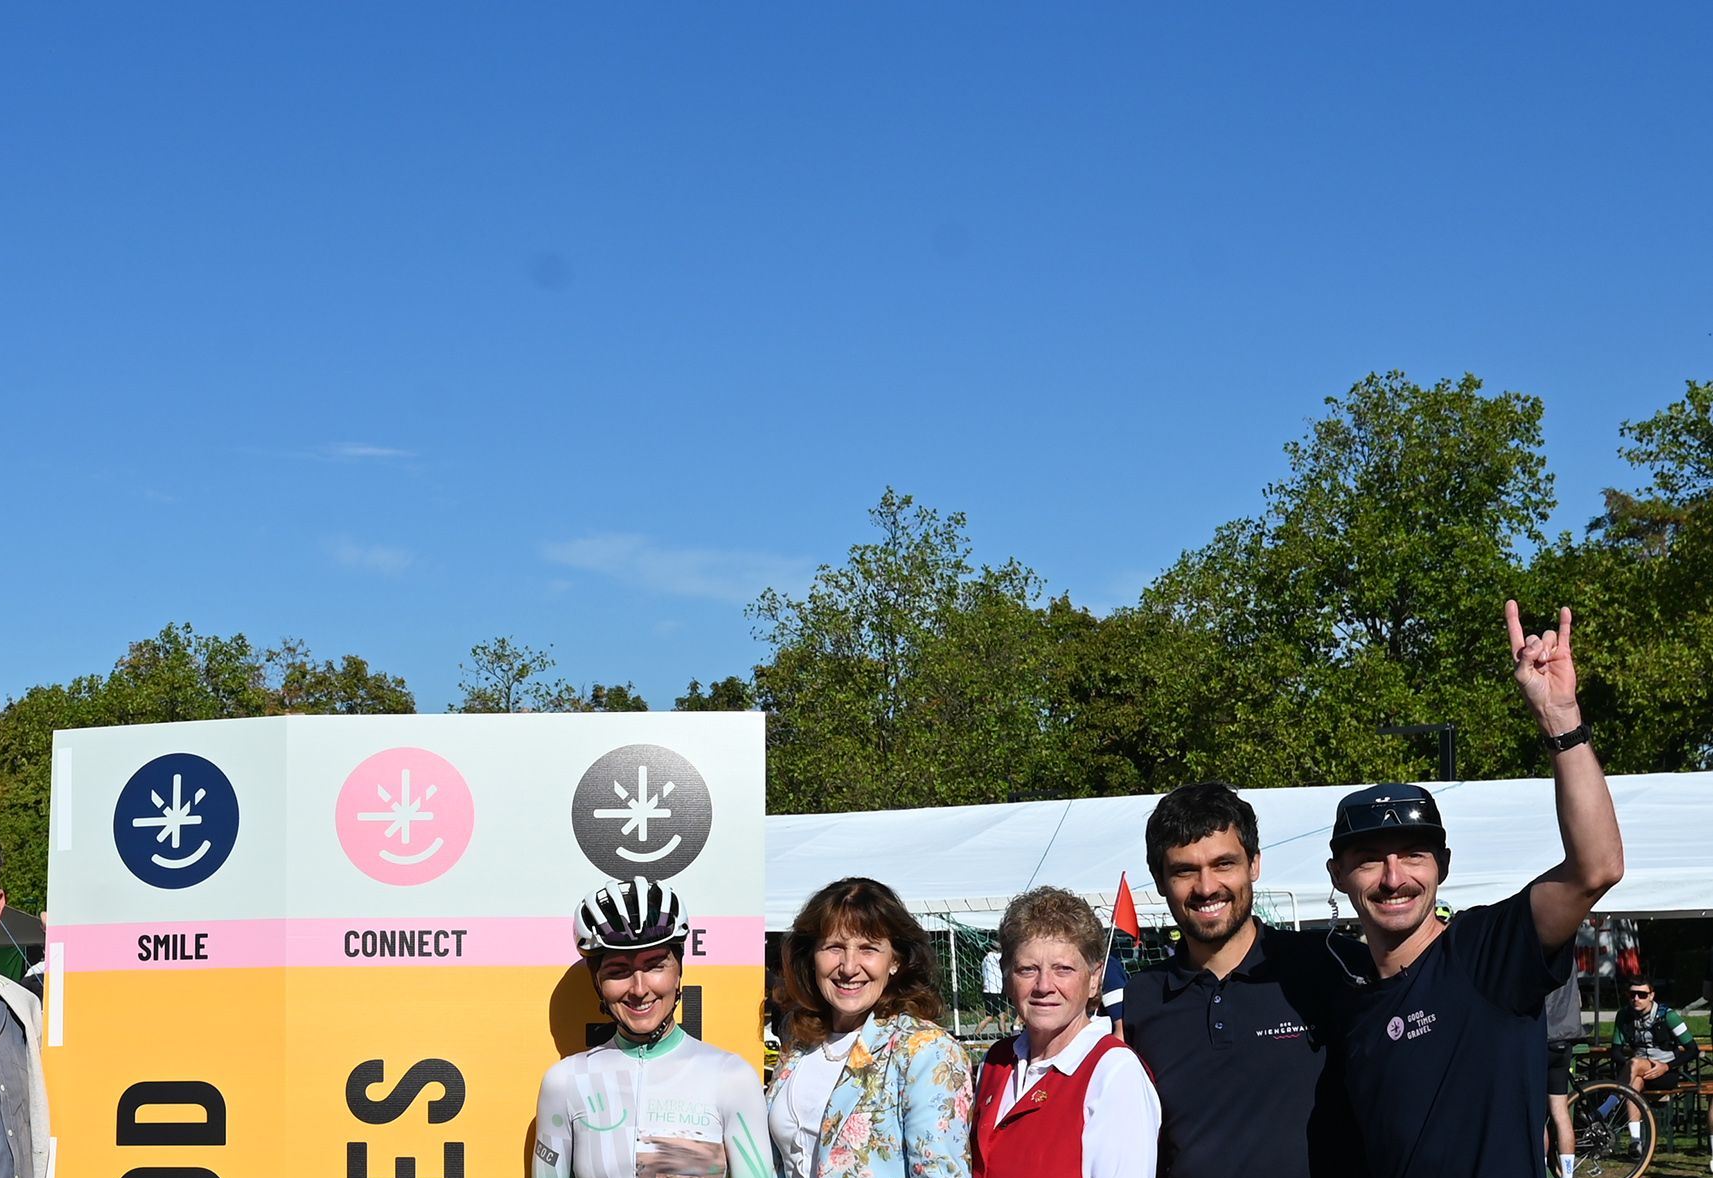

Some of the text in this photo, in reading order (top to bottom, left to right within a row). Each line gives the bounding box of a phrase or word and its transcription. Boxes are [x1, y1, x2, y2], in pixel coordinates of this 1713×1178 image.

[137, 933, 208, 961] SMILE
[344, 929, 467, 958] CONNECT
[1407, 1010, 1425, 1023] GOOD
[1417, 1014, 1437, 1027] TIMES
[1407, 1026, 1432, 1040] GRAVEL
[647, 1111, 711, 1127] THE MUD
